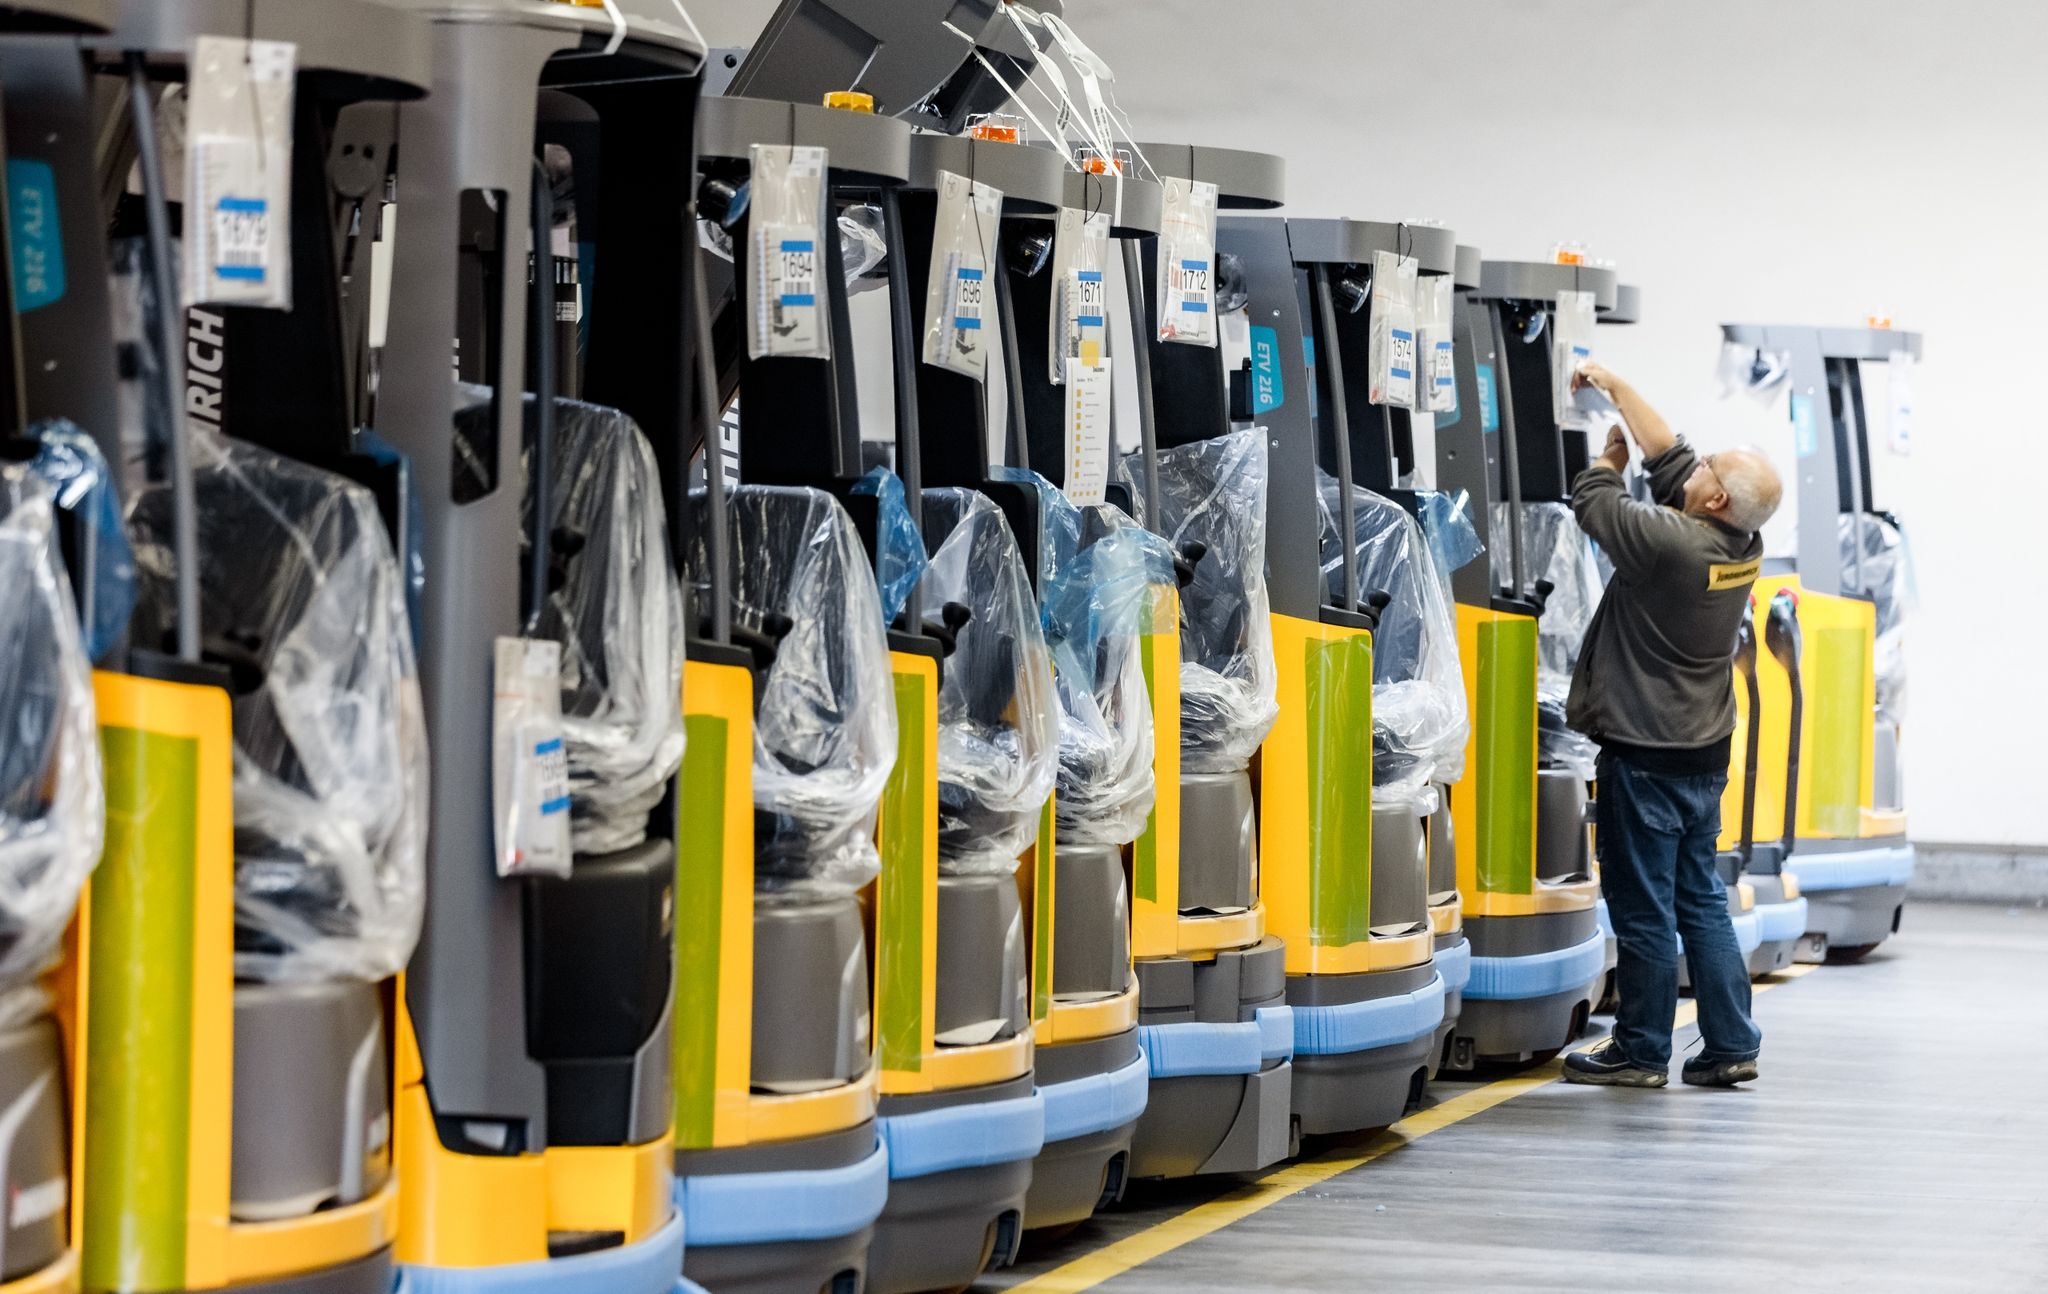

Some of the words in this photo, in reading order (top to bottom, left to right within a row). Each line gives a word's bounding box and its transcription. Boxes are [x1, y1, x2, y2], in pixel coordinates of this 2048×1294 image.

[782, 253, 812, 278] 1694
[958, 280, 981, 304] 1696
[1079, 282, 1101, 302] 1671
[1183, 270, 1207, 290] 1712
[1257, 341, 1271, 373] ETV
[1393, 339, 1411, 358] 1574
[1259, 374, 1273, 405] 216
